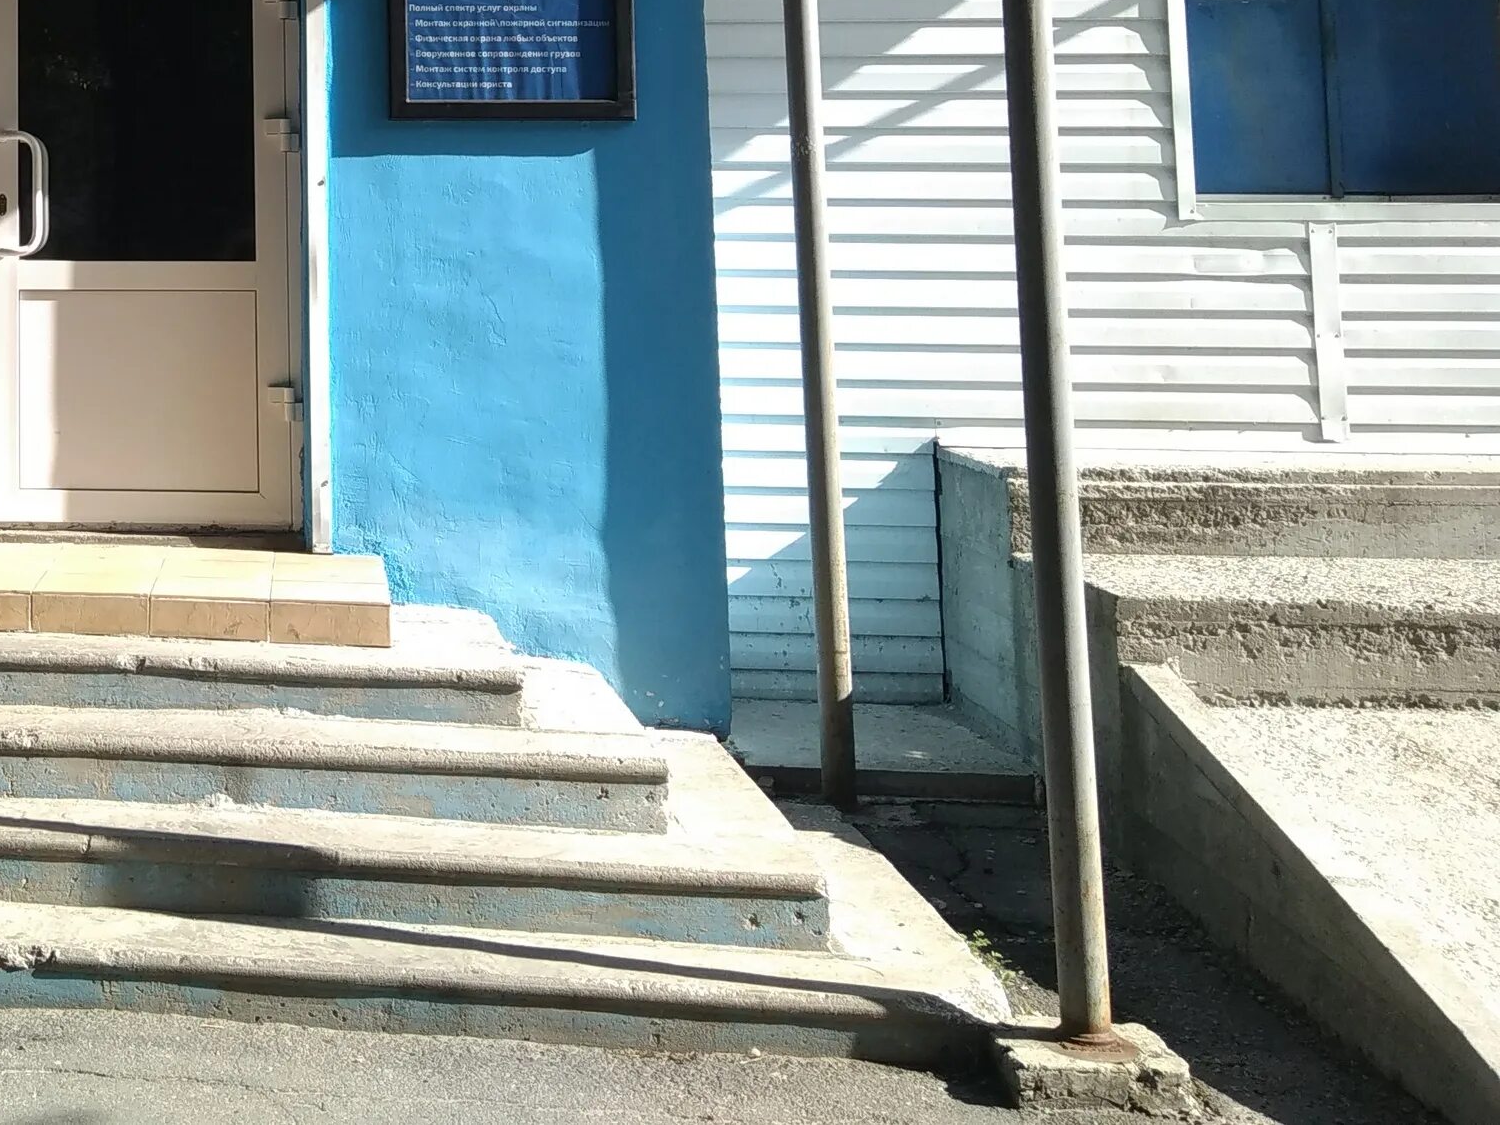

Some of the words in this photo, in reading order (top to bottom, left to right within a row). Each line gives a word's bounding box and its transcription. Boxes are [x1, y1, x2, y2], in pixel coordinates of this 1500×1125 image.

[408, 3, 444, 13] Полный
[445, 5, 476, 14] спектр
[477, 5, 502, 14] услуг
[503, 5, 538, 13] охраны
[415, 19, 451, 28] Монтаж
[546, 20, 610, 28] сигнализации
[415, 34, 469, 43] Физическая
[469, 36, 502, 44] охрана
[503, 34, 535, 43] любых
[535, 34, 579, 43] объектов
[415, 50, 477, 59] Вооруженное
[477, 50, 549, 59] сопровождение
[550, 50, 581, 59] грузов
[415, 65, 452, 73] Монтаж
[453, 66, 486, 74] систем
[486, 65, 529, 74] контроля
[530, 65, 567, 75] доступа
[415, 80, 478, 90] Консультации
[479, 80, 513, 90] юриста
